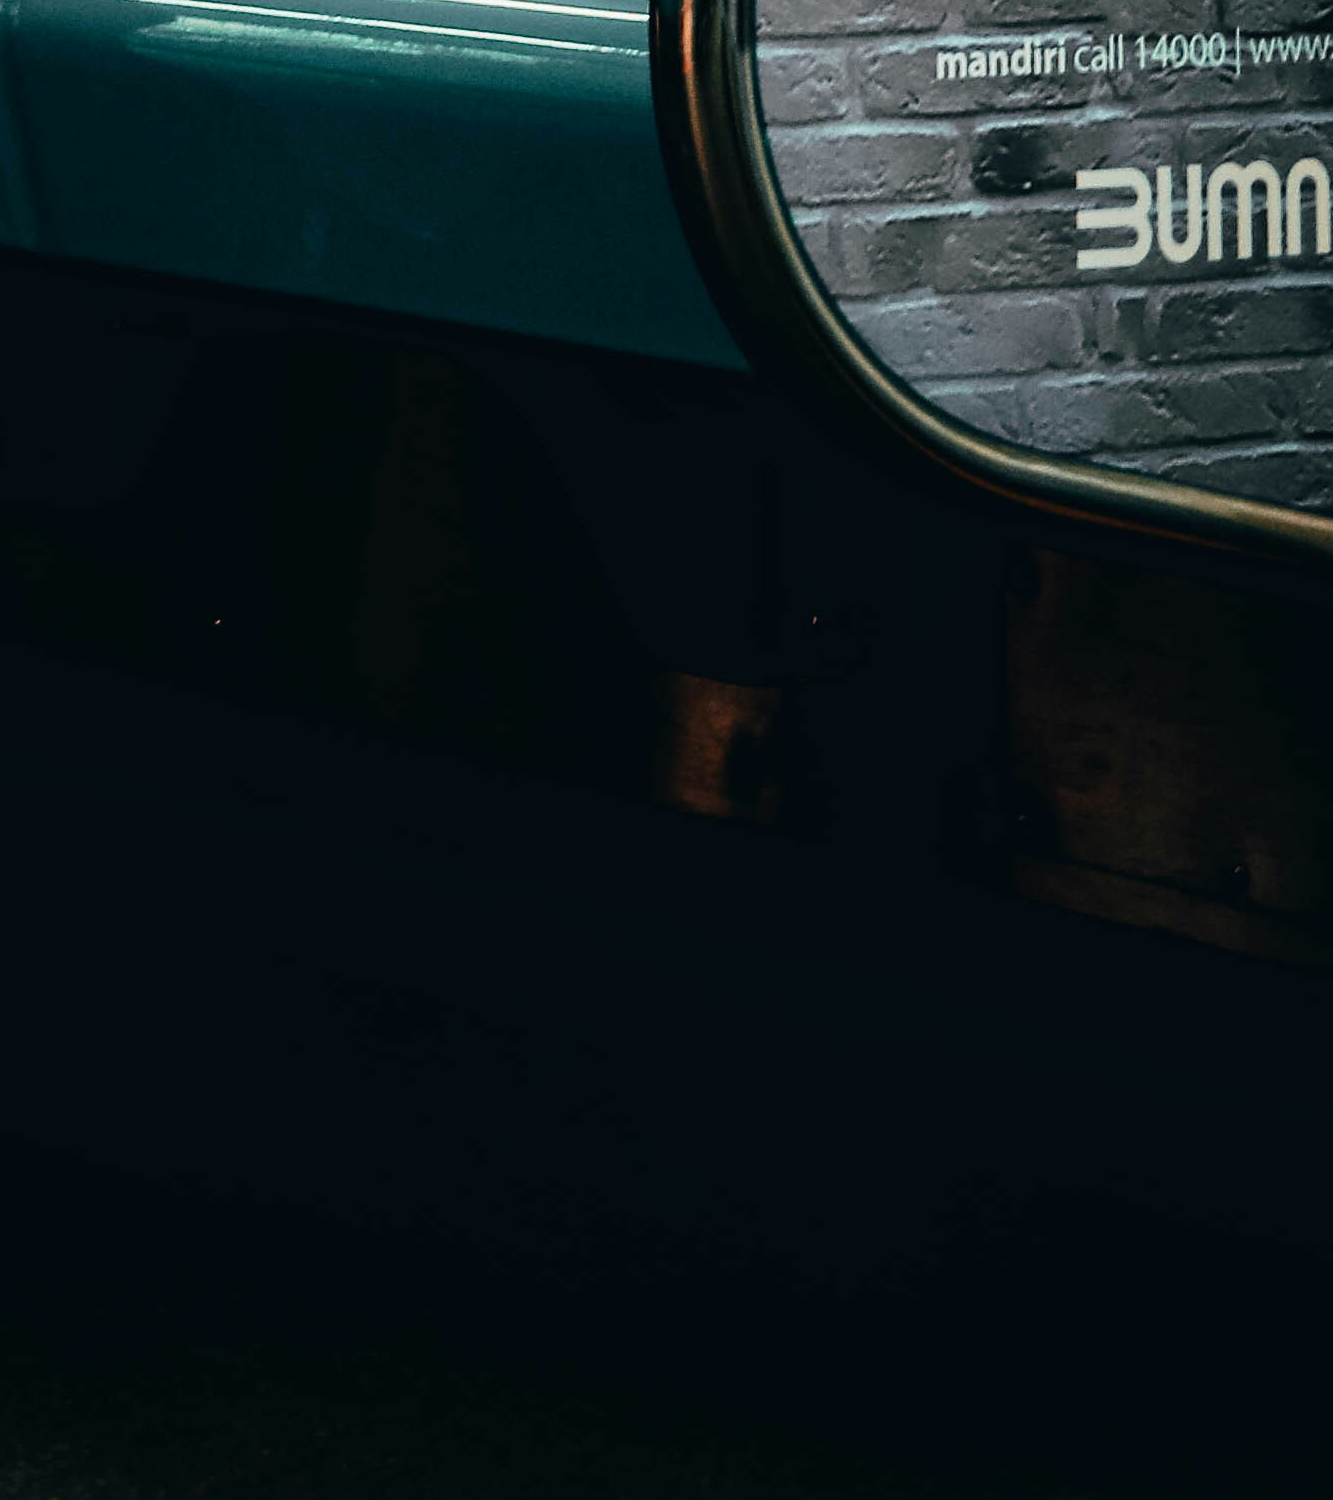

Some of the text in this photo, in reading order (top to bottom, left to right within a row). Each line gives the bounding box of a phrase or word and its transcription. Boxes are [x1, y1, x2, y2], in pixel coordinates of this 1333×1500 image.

[935, 35, 1067, 82] mandiri
[1073, 33, 1125, 74] call
[1133, 30, 1227, 72] 14000
[1075, 156, 1333, 271] BUMN
